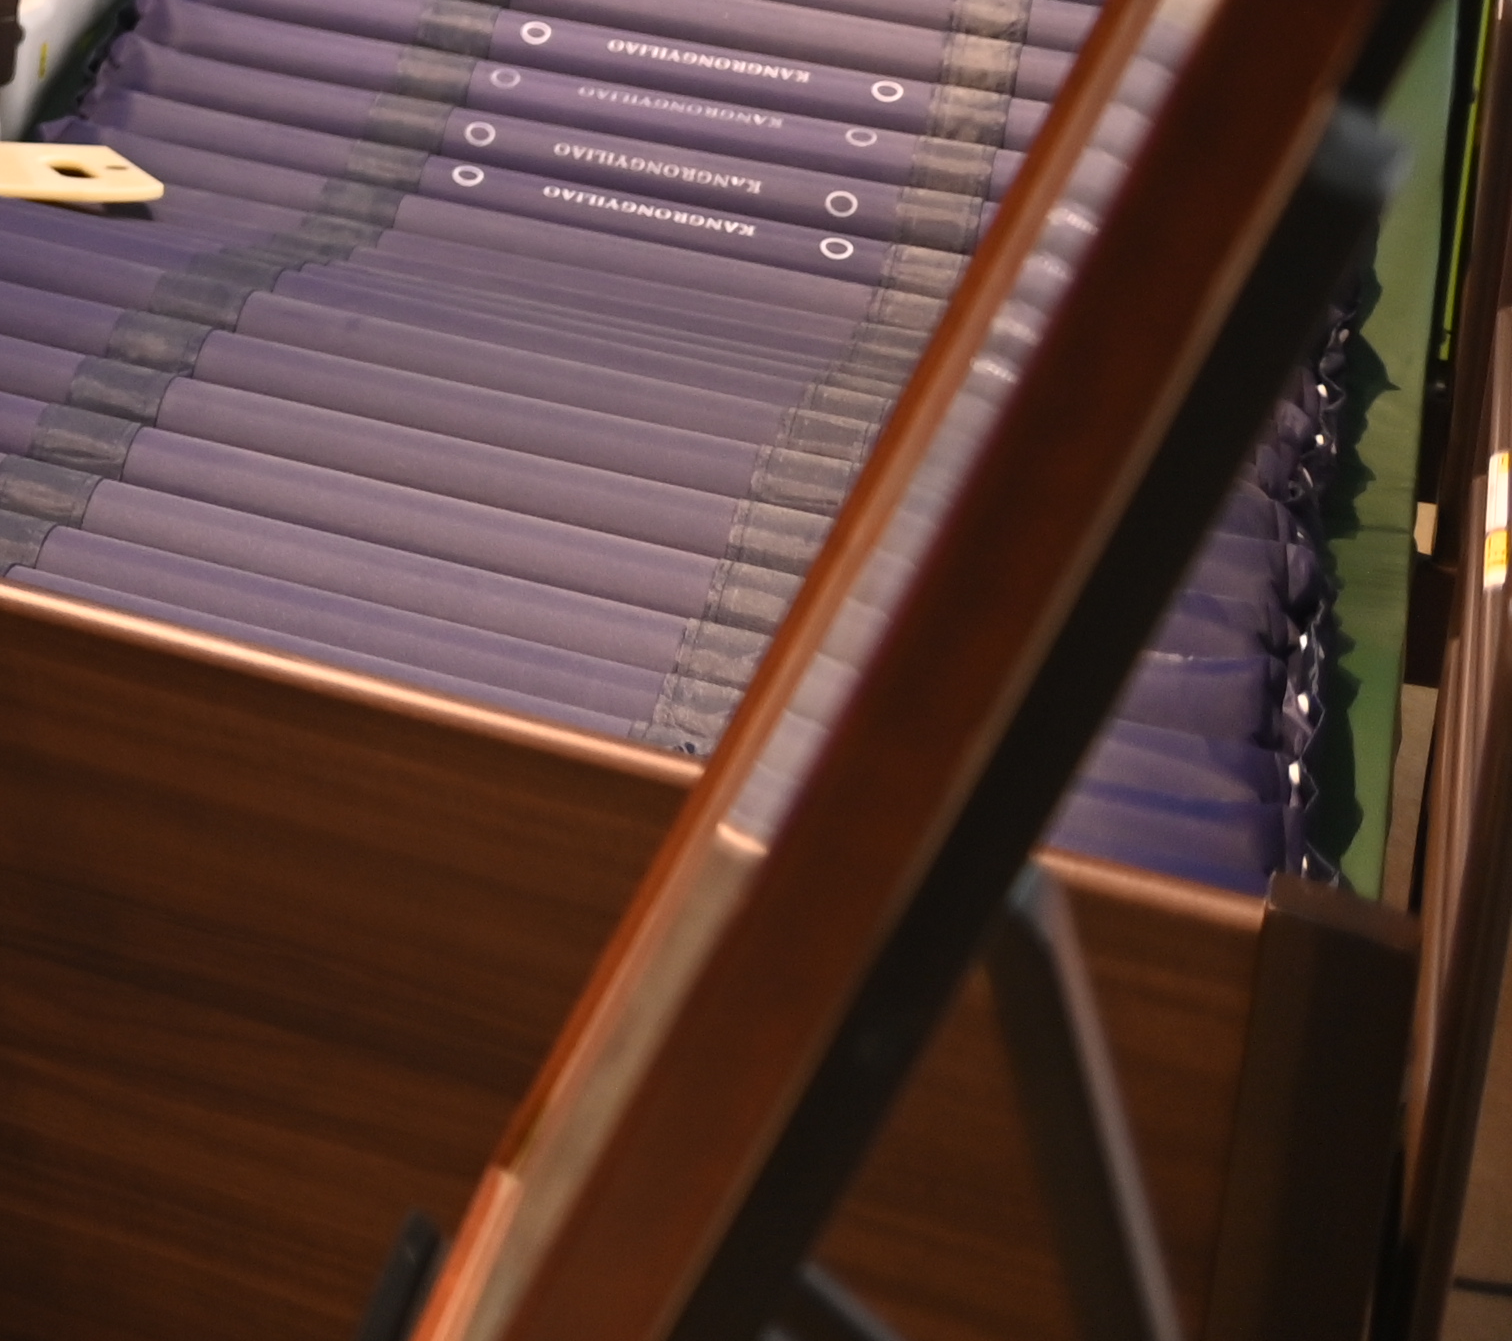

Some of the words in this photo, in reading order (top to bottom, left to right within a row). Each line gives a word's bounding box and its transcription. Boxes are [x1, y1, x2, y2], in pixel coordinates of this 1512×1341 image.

[607, 38, 810, 84] KANGRONGYILIAO
[578, 85, 783, 129] KANGRONGYILIAO
[553, 141, 762, 194] KANGRONGYILIAO
[543, 185, 756, 237] KANGRONGYILIAO
